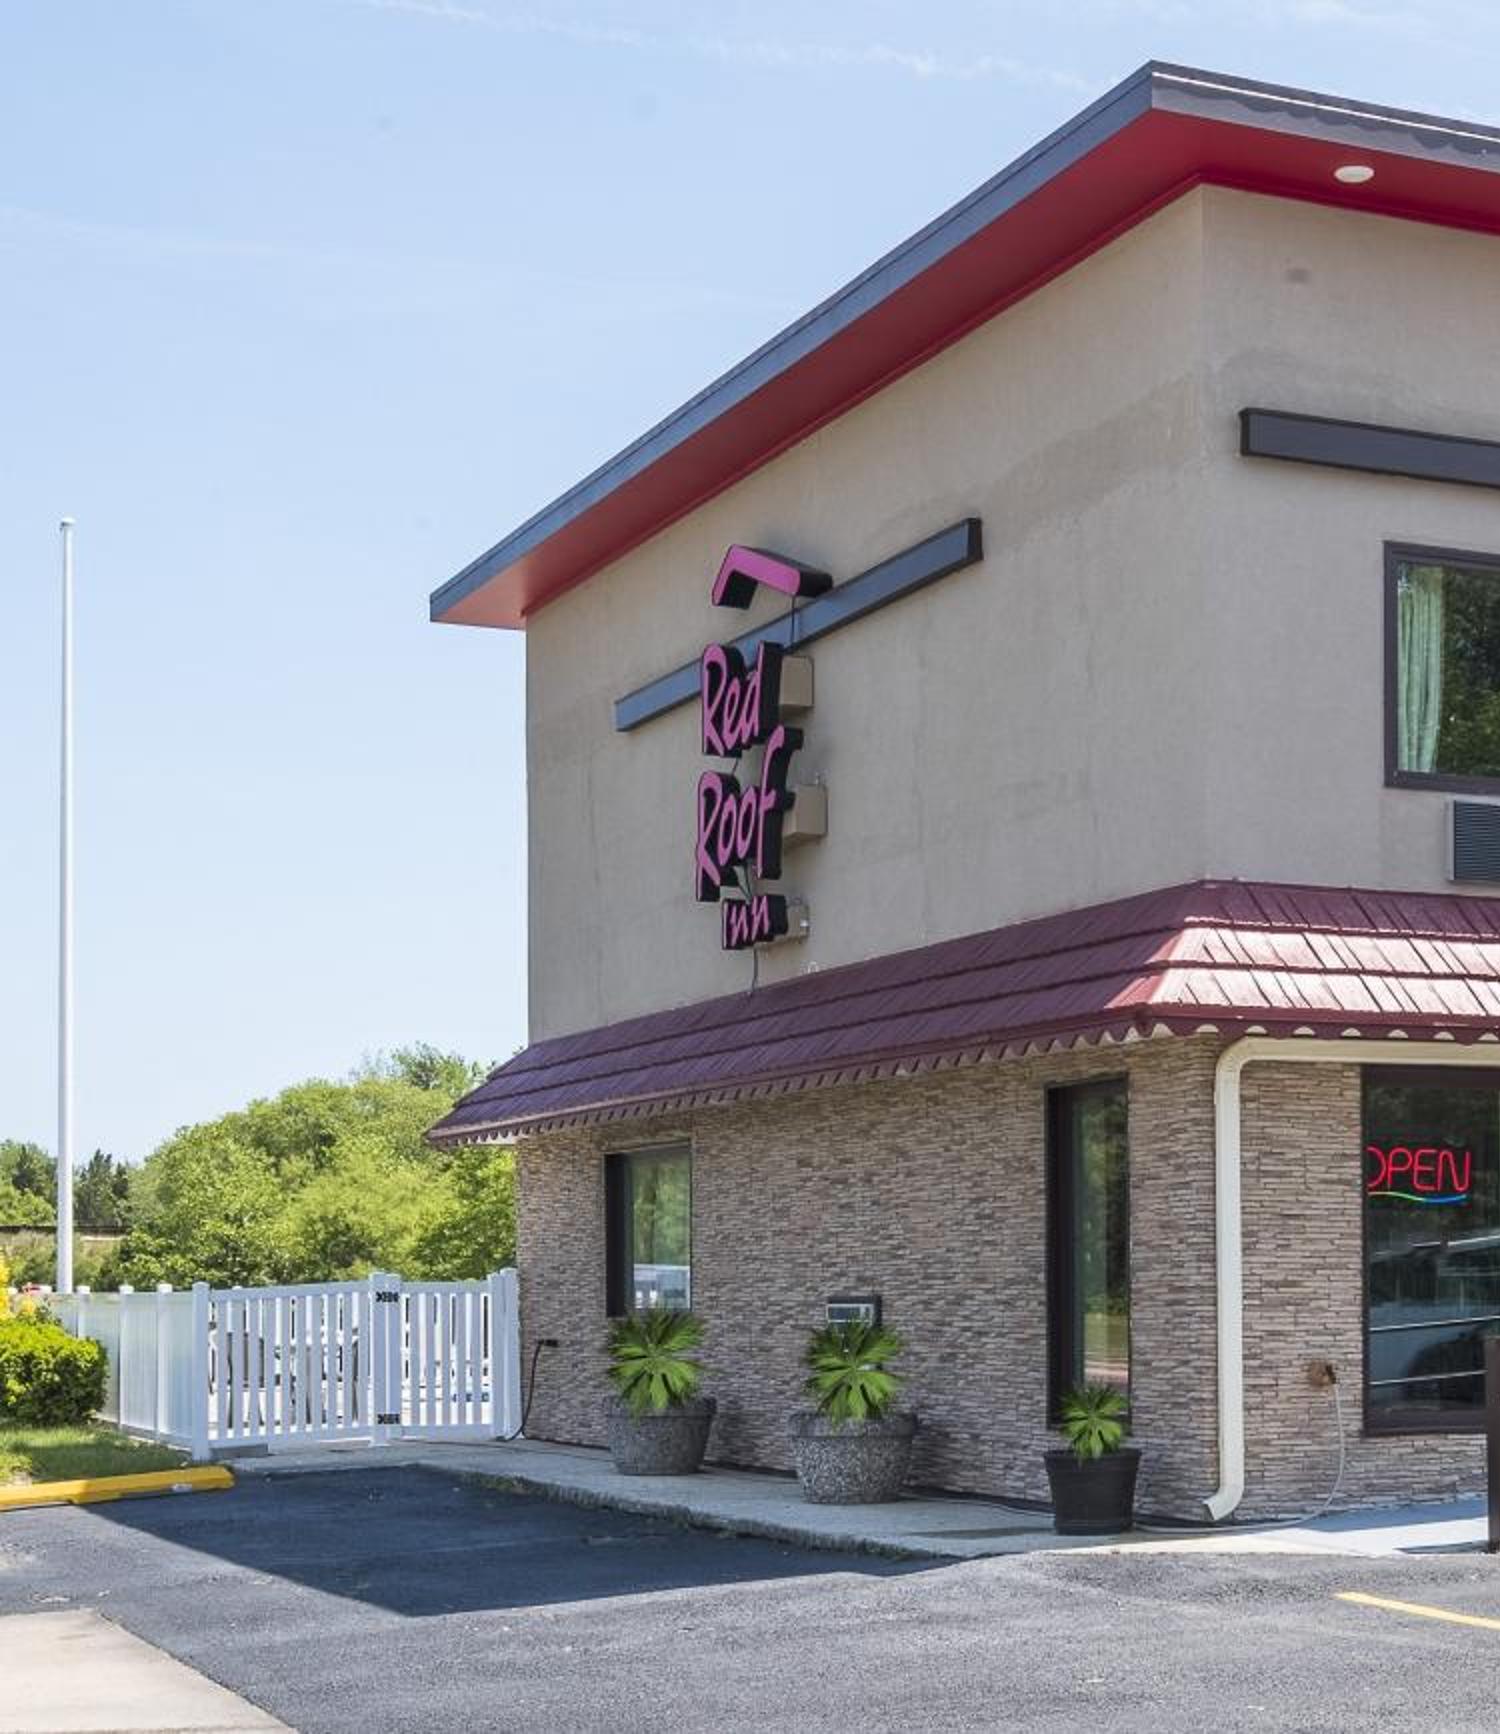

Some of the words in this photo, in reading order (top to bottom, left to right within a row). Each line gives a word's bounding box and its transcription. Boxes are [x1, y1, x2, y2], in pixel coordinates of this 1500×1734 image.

[702, 641, 766, 757] Red
[697, 725, 786, 900] Roof
[1365, 1145, 1471, 1192] OPEN
